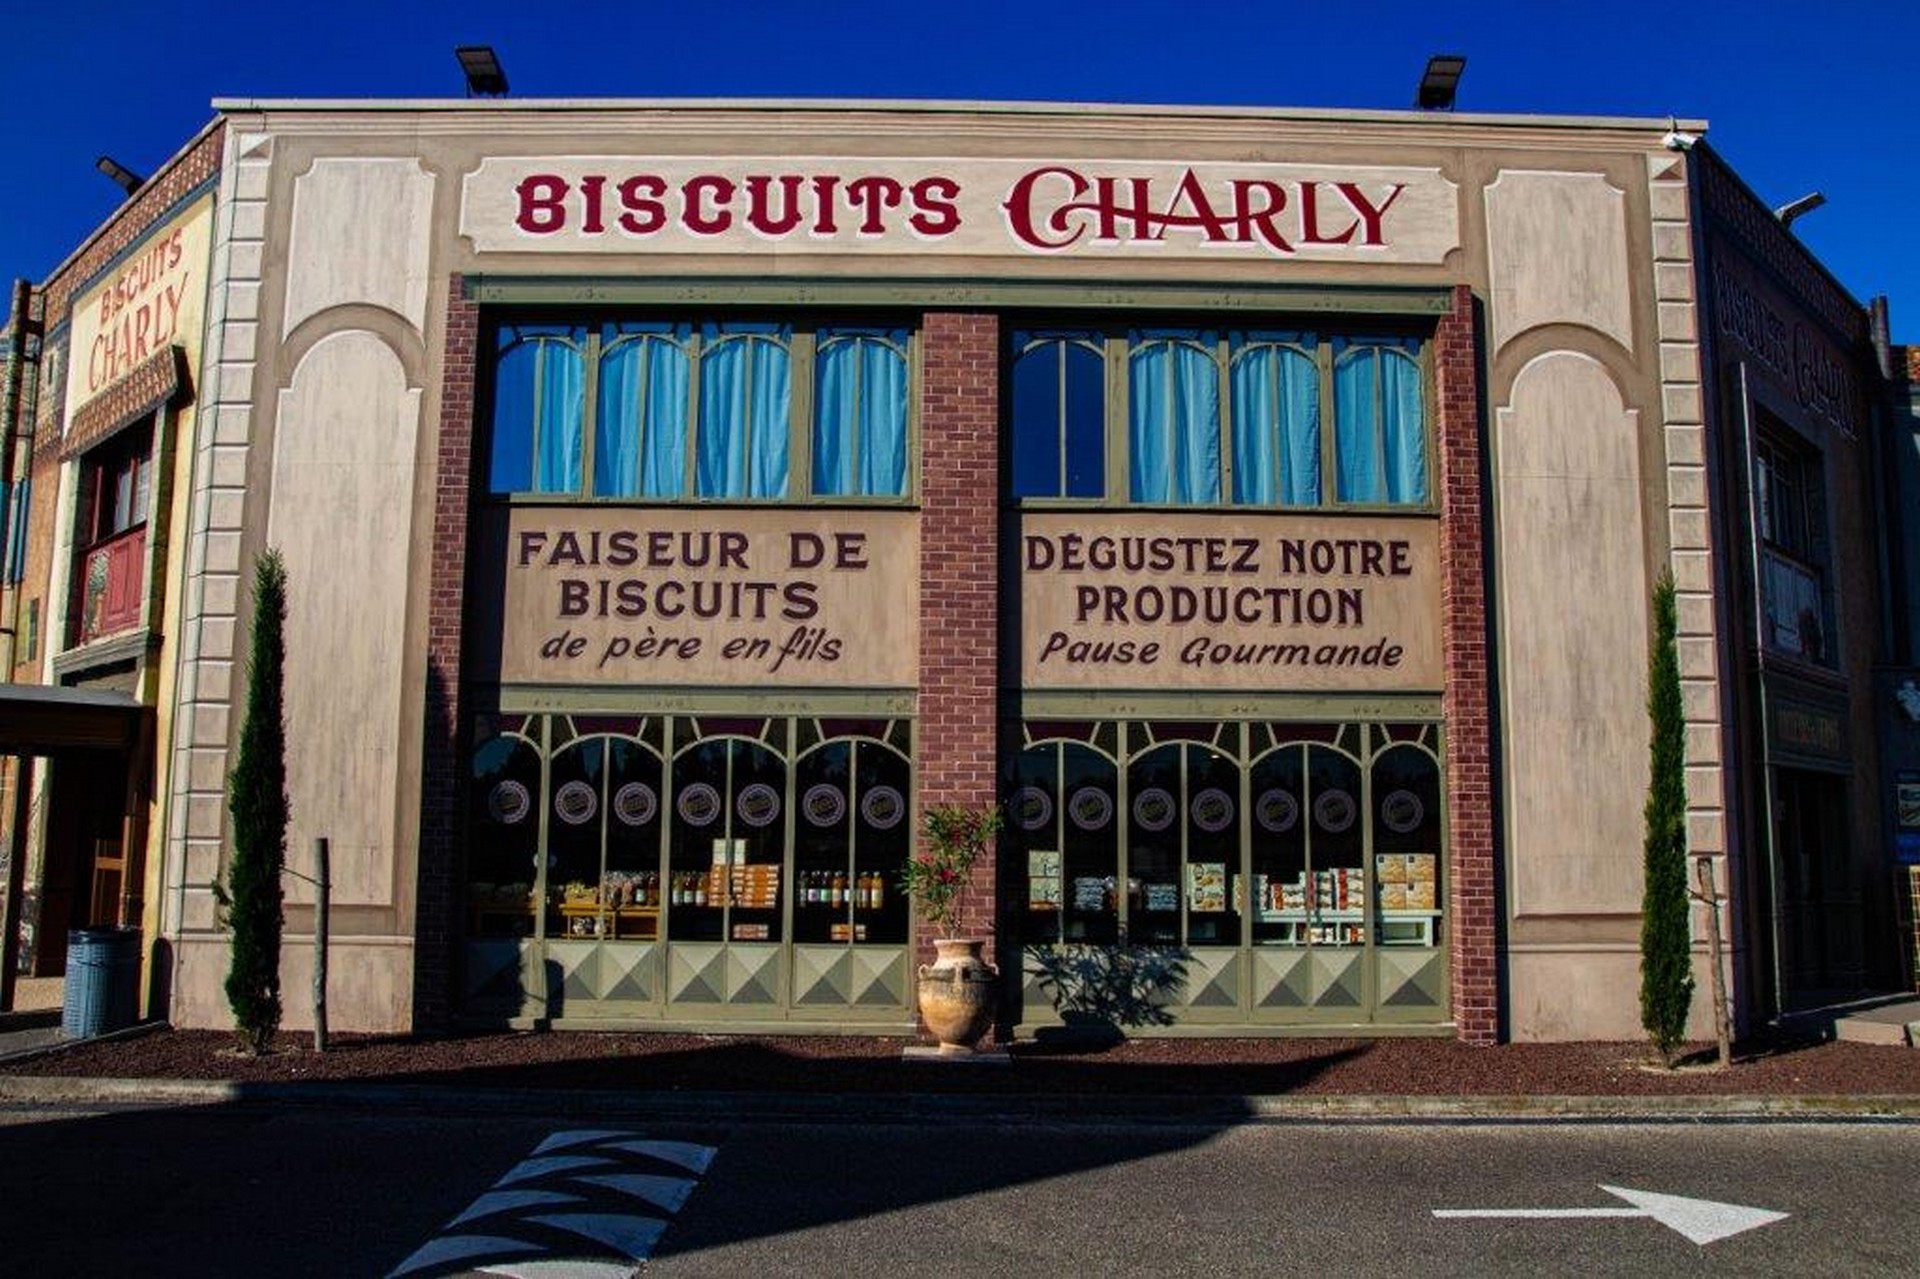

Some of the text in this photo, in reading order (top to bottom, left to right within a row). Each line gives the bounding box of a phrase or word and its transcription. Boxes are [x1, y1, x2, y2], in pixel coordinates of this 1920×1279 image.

[514, 166, 1405, 253] BISCUITS CHARLY
[101, 227, 182, 325] BISCUITS
[89, 272, 188, 392] CHARLY
[518, 531, 869, 570] FAISEUR DE
[1024, 533, 1412, 577] DÉGUSTEZ NOTRE
[558, 579, 820, 620] BISCUITS
[1075, 584, 1364, 625] PRODUCTION
[541, 626, 843, 674] de père en fils
[1039, 631, 1404, 667] Pause Gourmande
